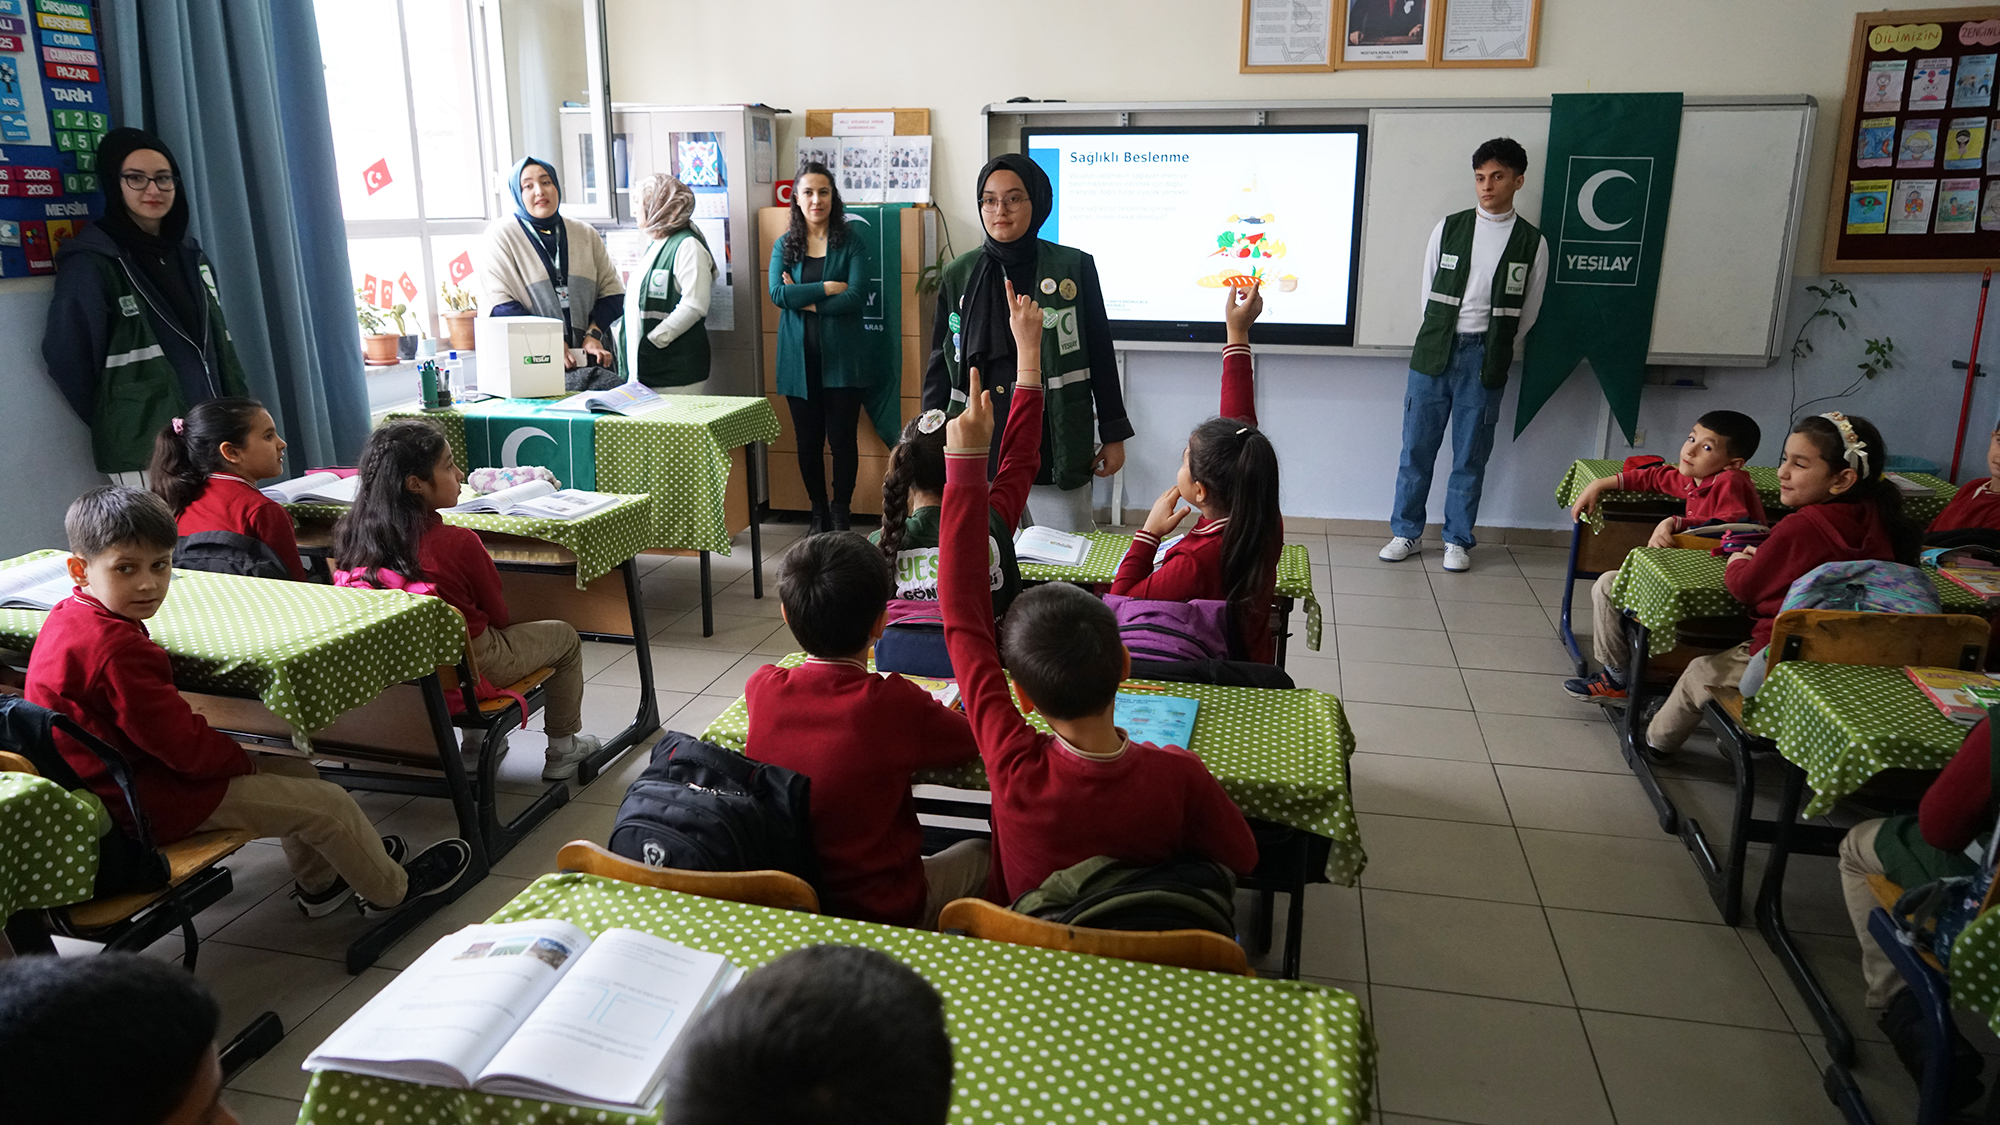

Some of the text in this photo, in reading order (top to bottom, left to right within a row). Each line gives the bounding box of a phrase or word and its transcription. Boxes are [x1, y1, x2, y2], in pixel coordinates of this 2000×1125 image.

[41, 0, 85, 17] ÇARŞAMBA
[43, 15, 88, 31] PERŞEMBE
[53, 34, 81, 46] CUMA
[1875, 30, 1939, 45] DİLİMİZİN
[56, 66, 90, 80] PAZAR
[51, 87, 93, 103] TARİH
[57, 112, 102, 128] 1 2 3
[61, 133, 71, 148] 4
[78, 134, 87, 149] 5
[81, 155, 91, 169] 7
[1070, 151, 1190, 166] Sağlıklı Beslenme
[23, 168, 51, 181] 2028
[26, 184, 54, 195] 2029
[45, 201, 89, 216] MEVSİM
[1566, 254, 1633, 272] YEŞİLAY
